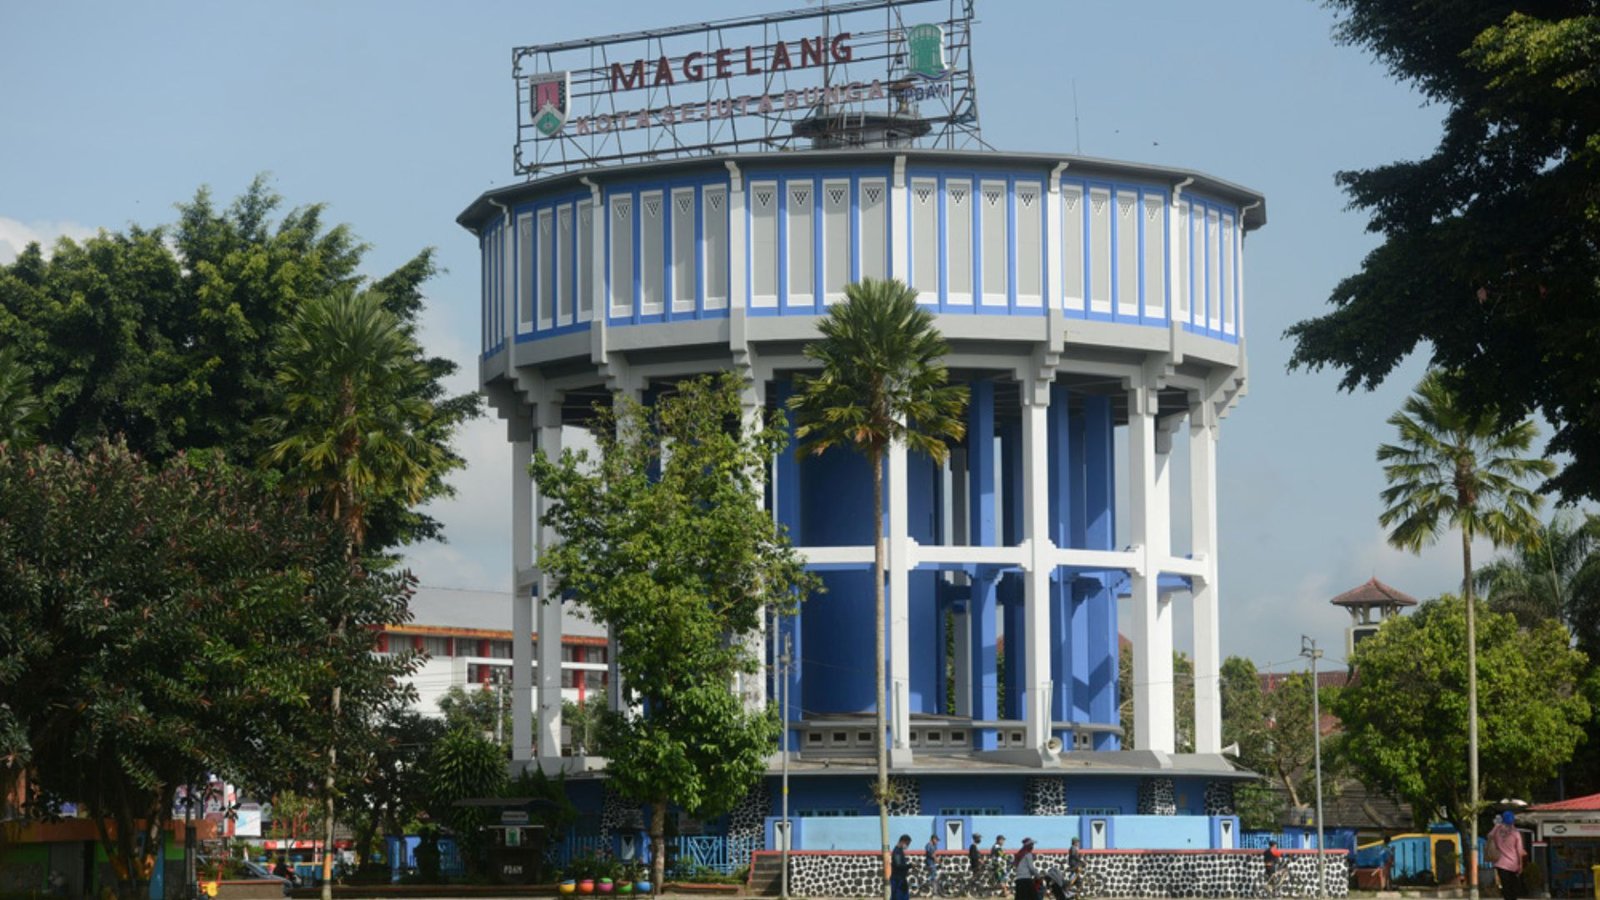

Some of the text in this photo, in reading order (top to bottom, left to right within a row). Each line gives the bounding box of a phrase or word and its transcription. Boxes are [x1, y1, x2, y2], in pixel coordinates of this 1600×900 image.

[610, 32, 853, 92] MAGELANG
[576, 79, 884, 135] KOTA SEJUTA BUNGA
[906, 82, 950, 102] PDAM
